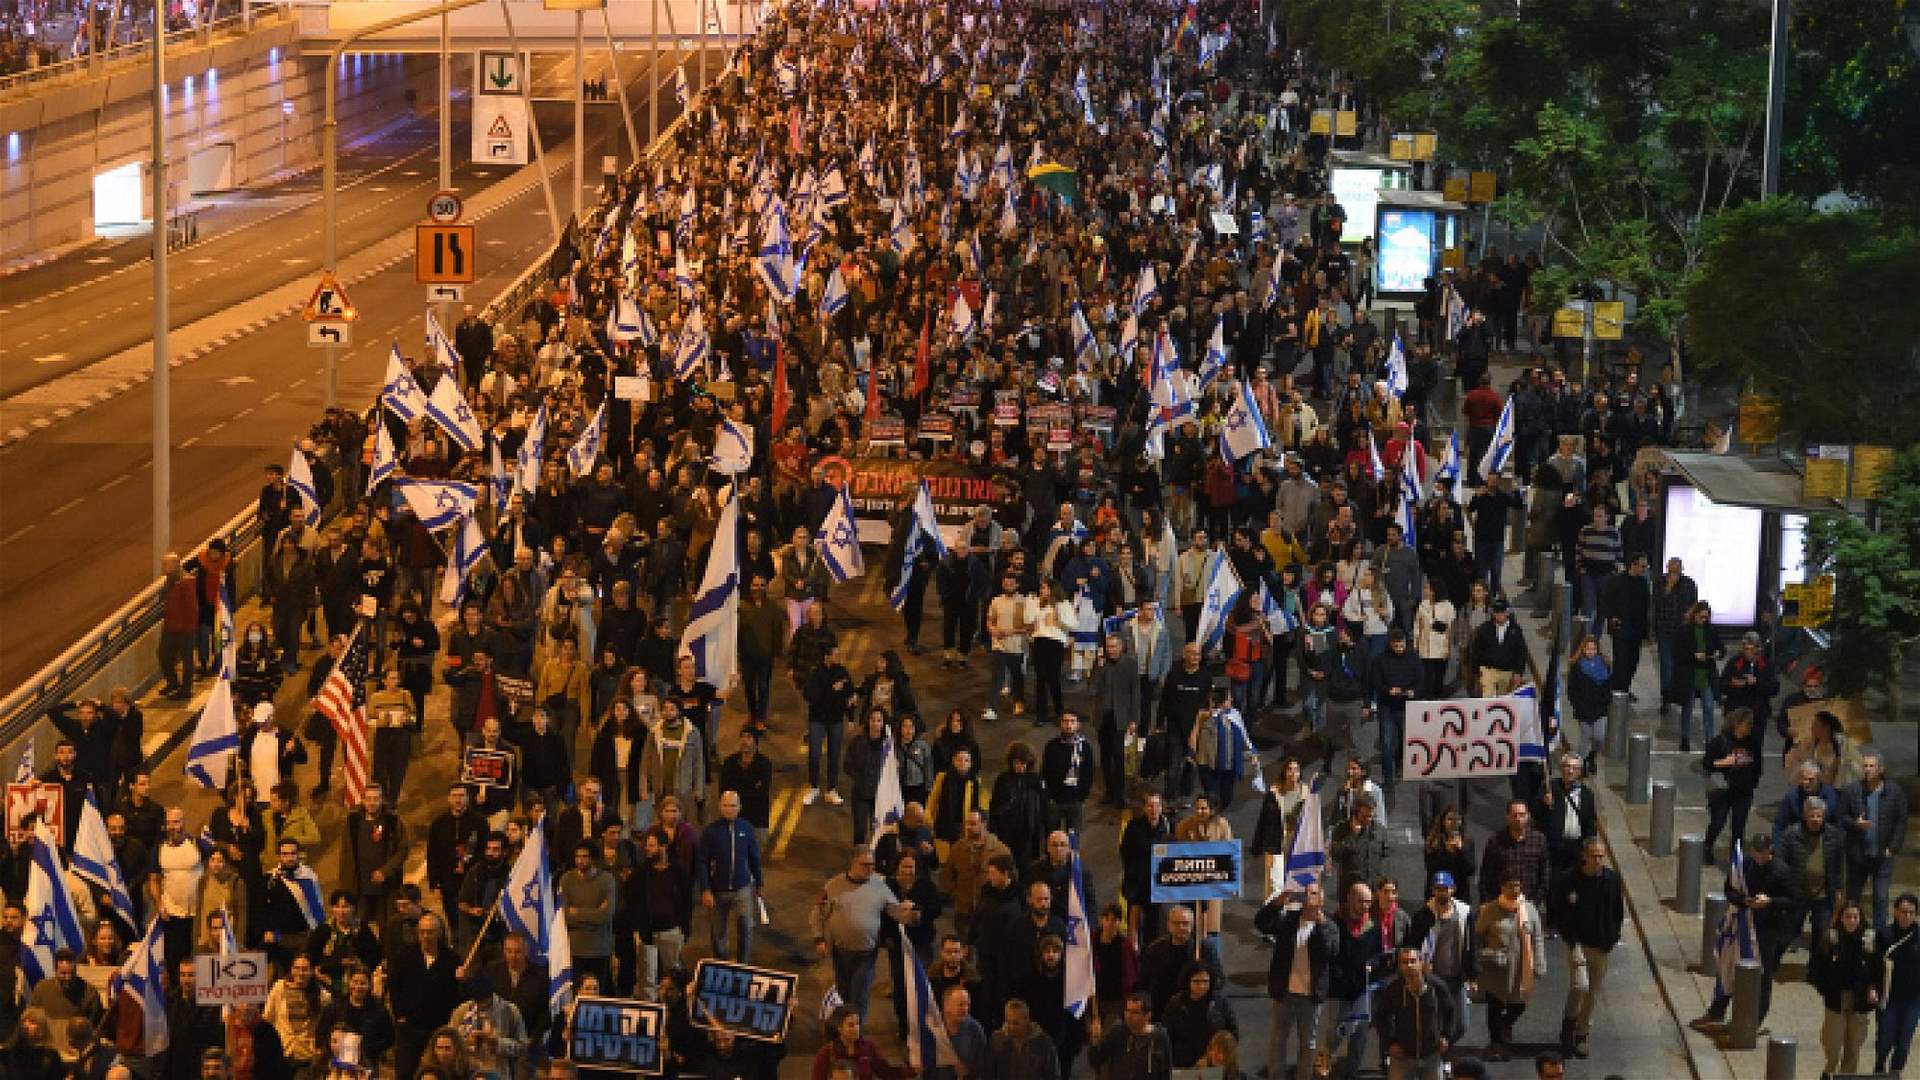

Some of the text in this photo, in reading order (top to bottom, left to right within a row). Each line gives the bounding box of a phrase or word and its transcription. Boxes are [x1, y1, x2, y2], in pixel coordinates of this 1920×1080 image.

[1423, 702, 1516, 738] ביבי
[1408, 738, 1516, 776] הביתה
[211, 958, 257, 987] כאן
